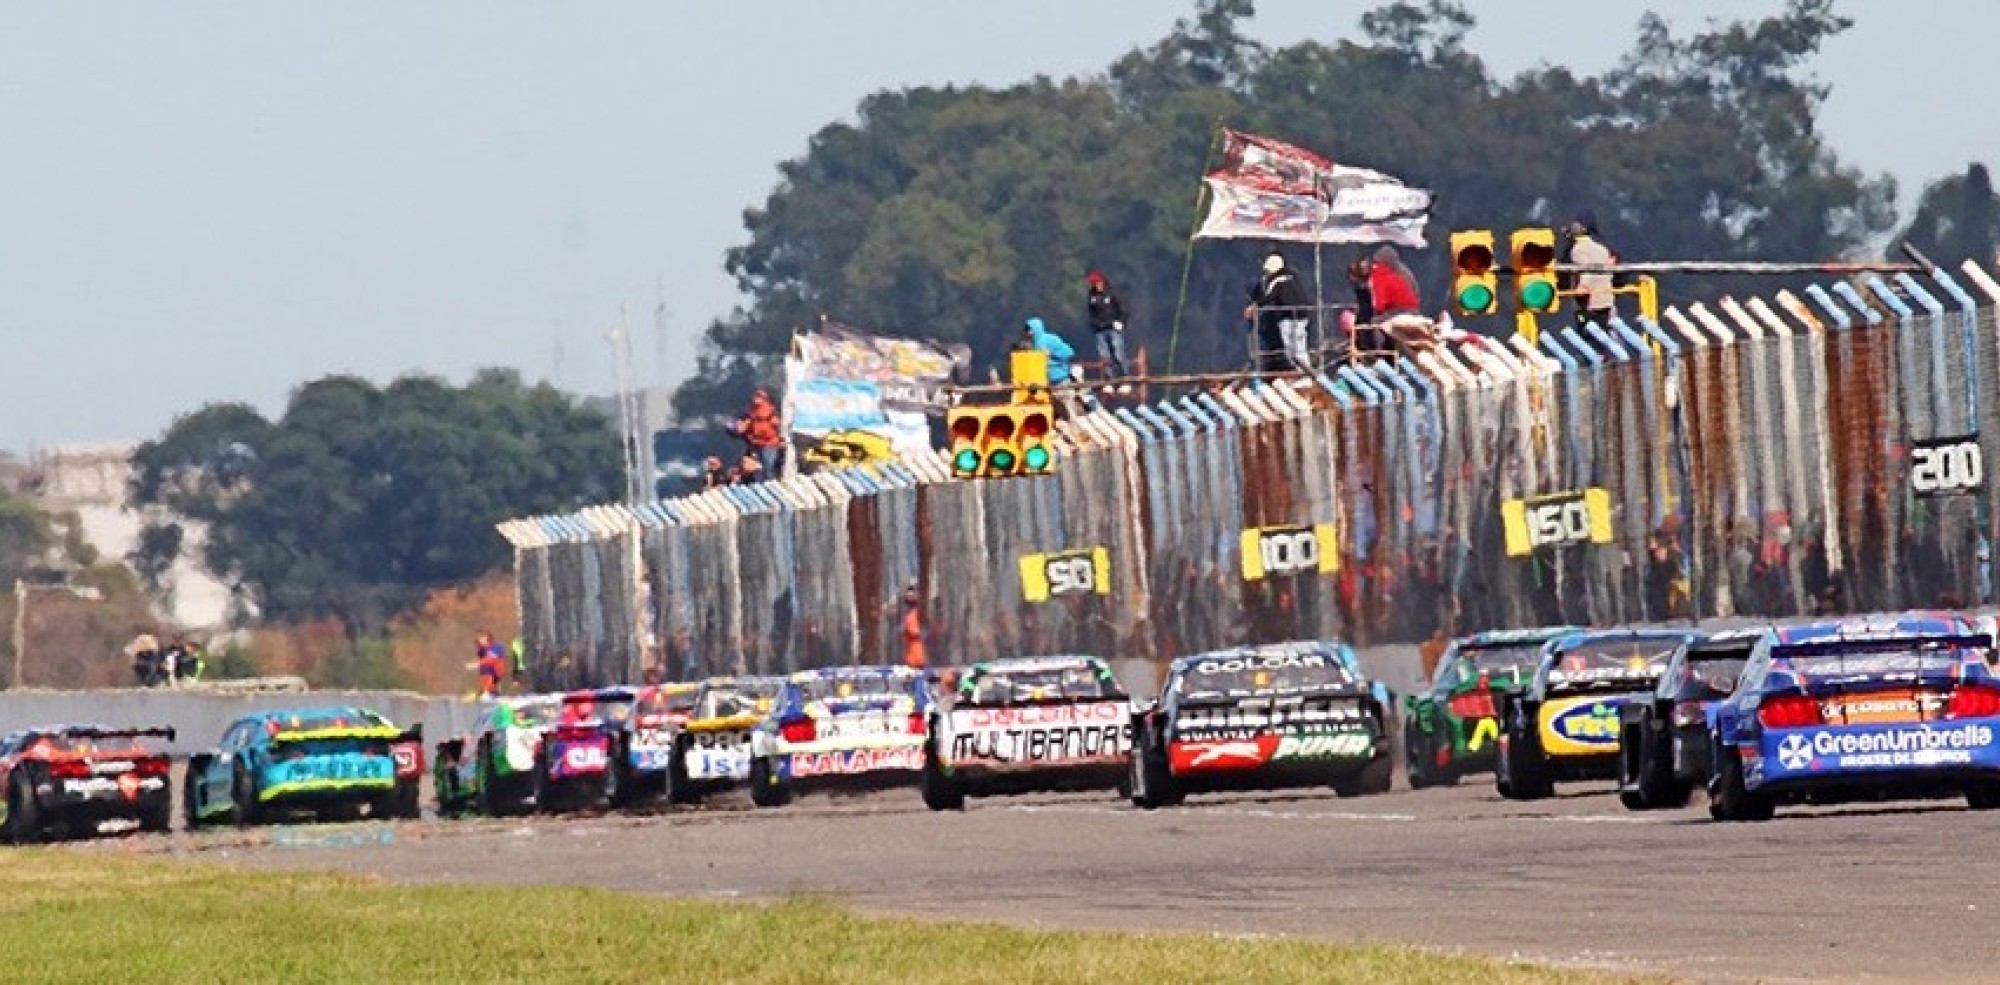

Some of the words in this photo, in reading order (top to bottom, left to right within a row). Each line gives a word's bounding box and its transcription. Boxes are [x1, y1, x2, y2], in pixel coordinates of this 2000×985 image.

[1911, 442, 1982, 491] 200
[1526, 501, 1589, 546] 150
[1261, 532, 1317, 570] 100
[1048, 558, 1092, 593] 50
[1814, 725, 1993, 754] GreenUmbrella
